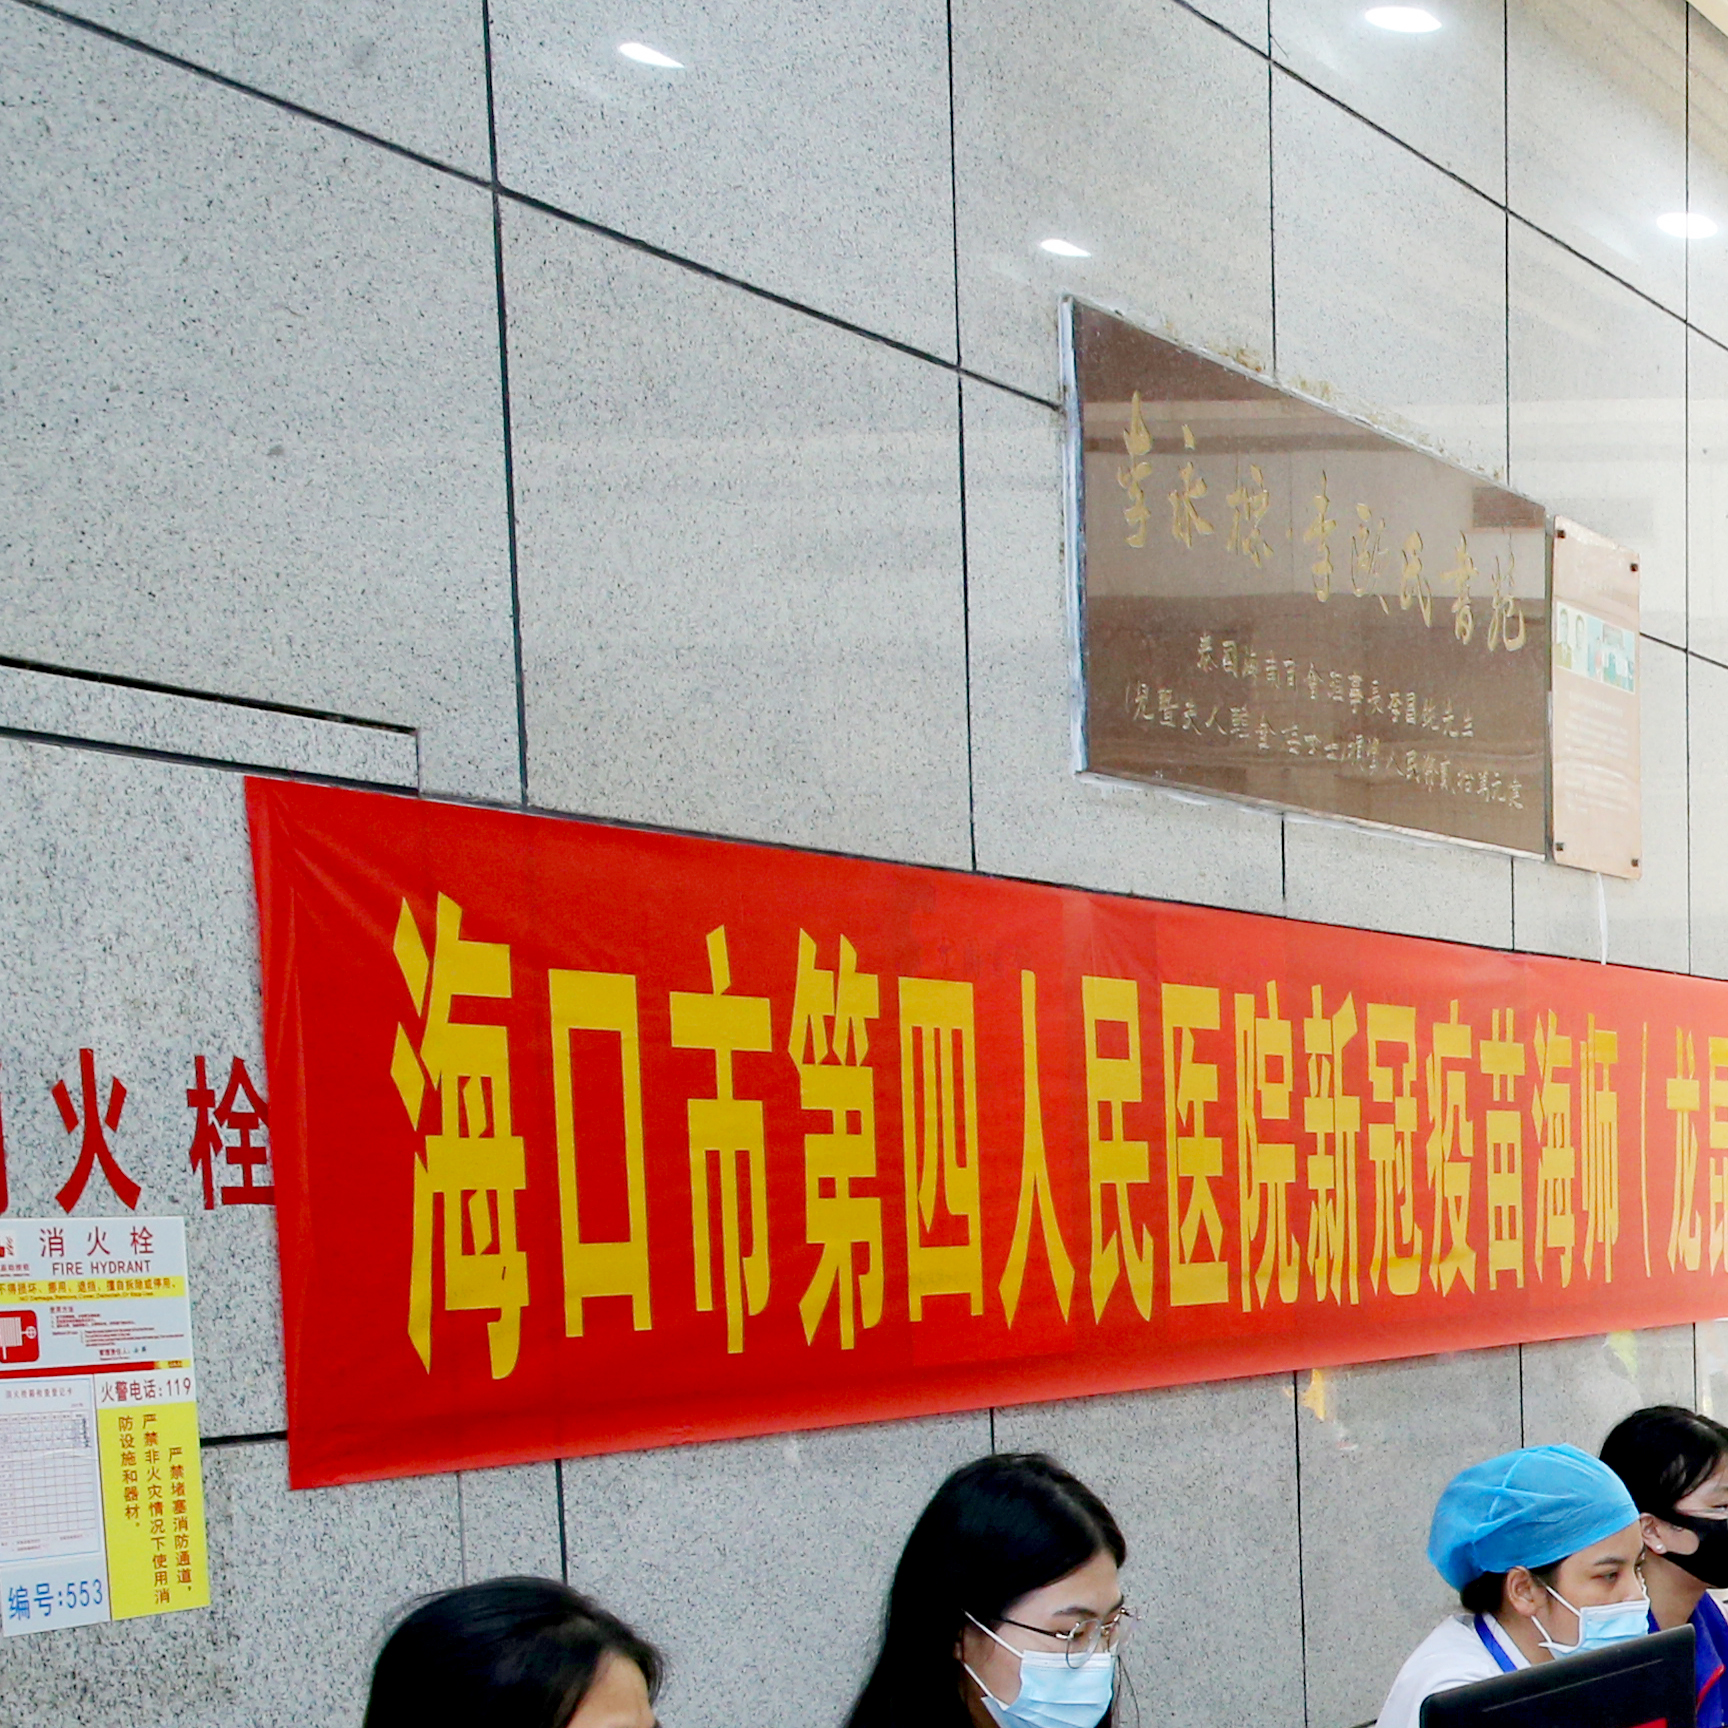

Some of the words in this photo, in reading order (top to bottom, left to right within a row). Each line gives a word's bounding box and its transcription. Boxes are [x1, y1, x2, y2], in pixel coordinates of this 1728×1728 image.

[0, 1047, 275, 1212] 火栓
[39, 1226, 155, 1258] 消火栓
[52, 1261, 83, 1275] FIRE
[90, 1259, 151, 1275] HYDRANT
[101, 1377, 191, 1402] 火警电话:119
[142, 1413, 170, 1604] 严禁非火灾情况下使用消
[8, 1578, 103, 1621] 编号:553
